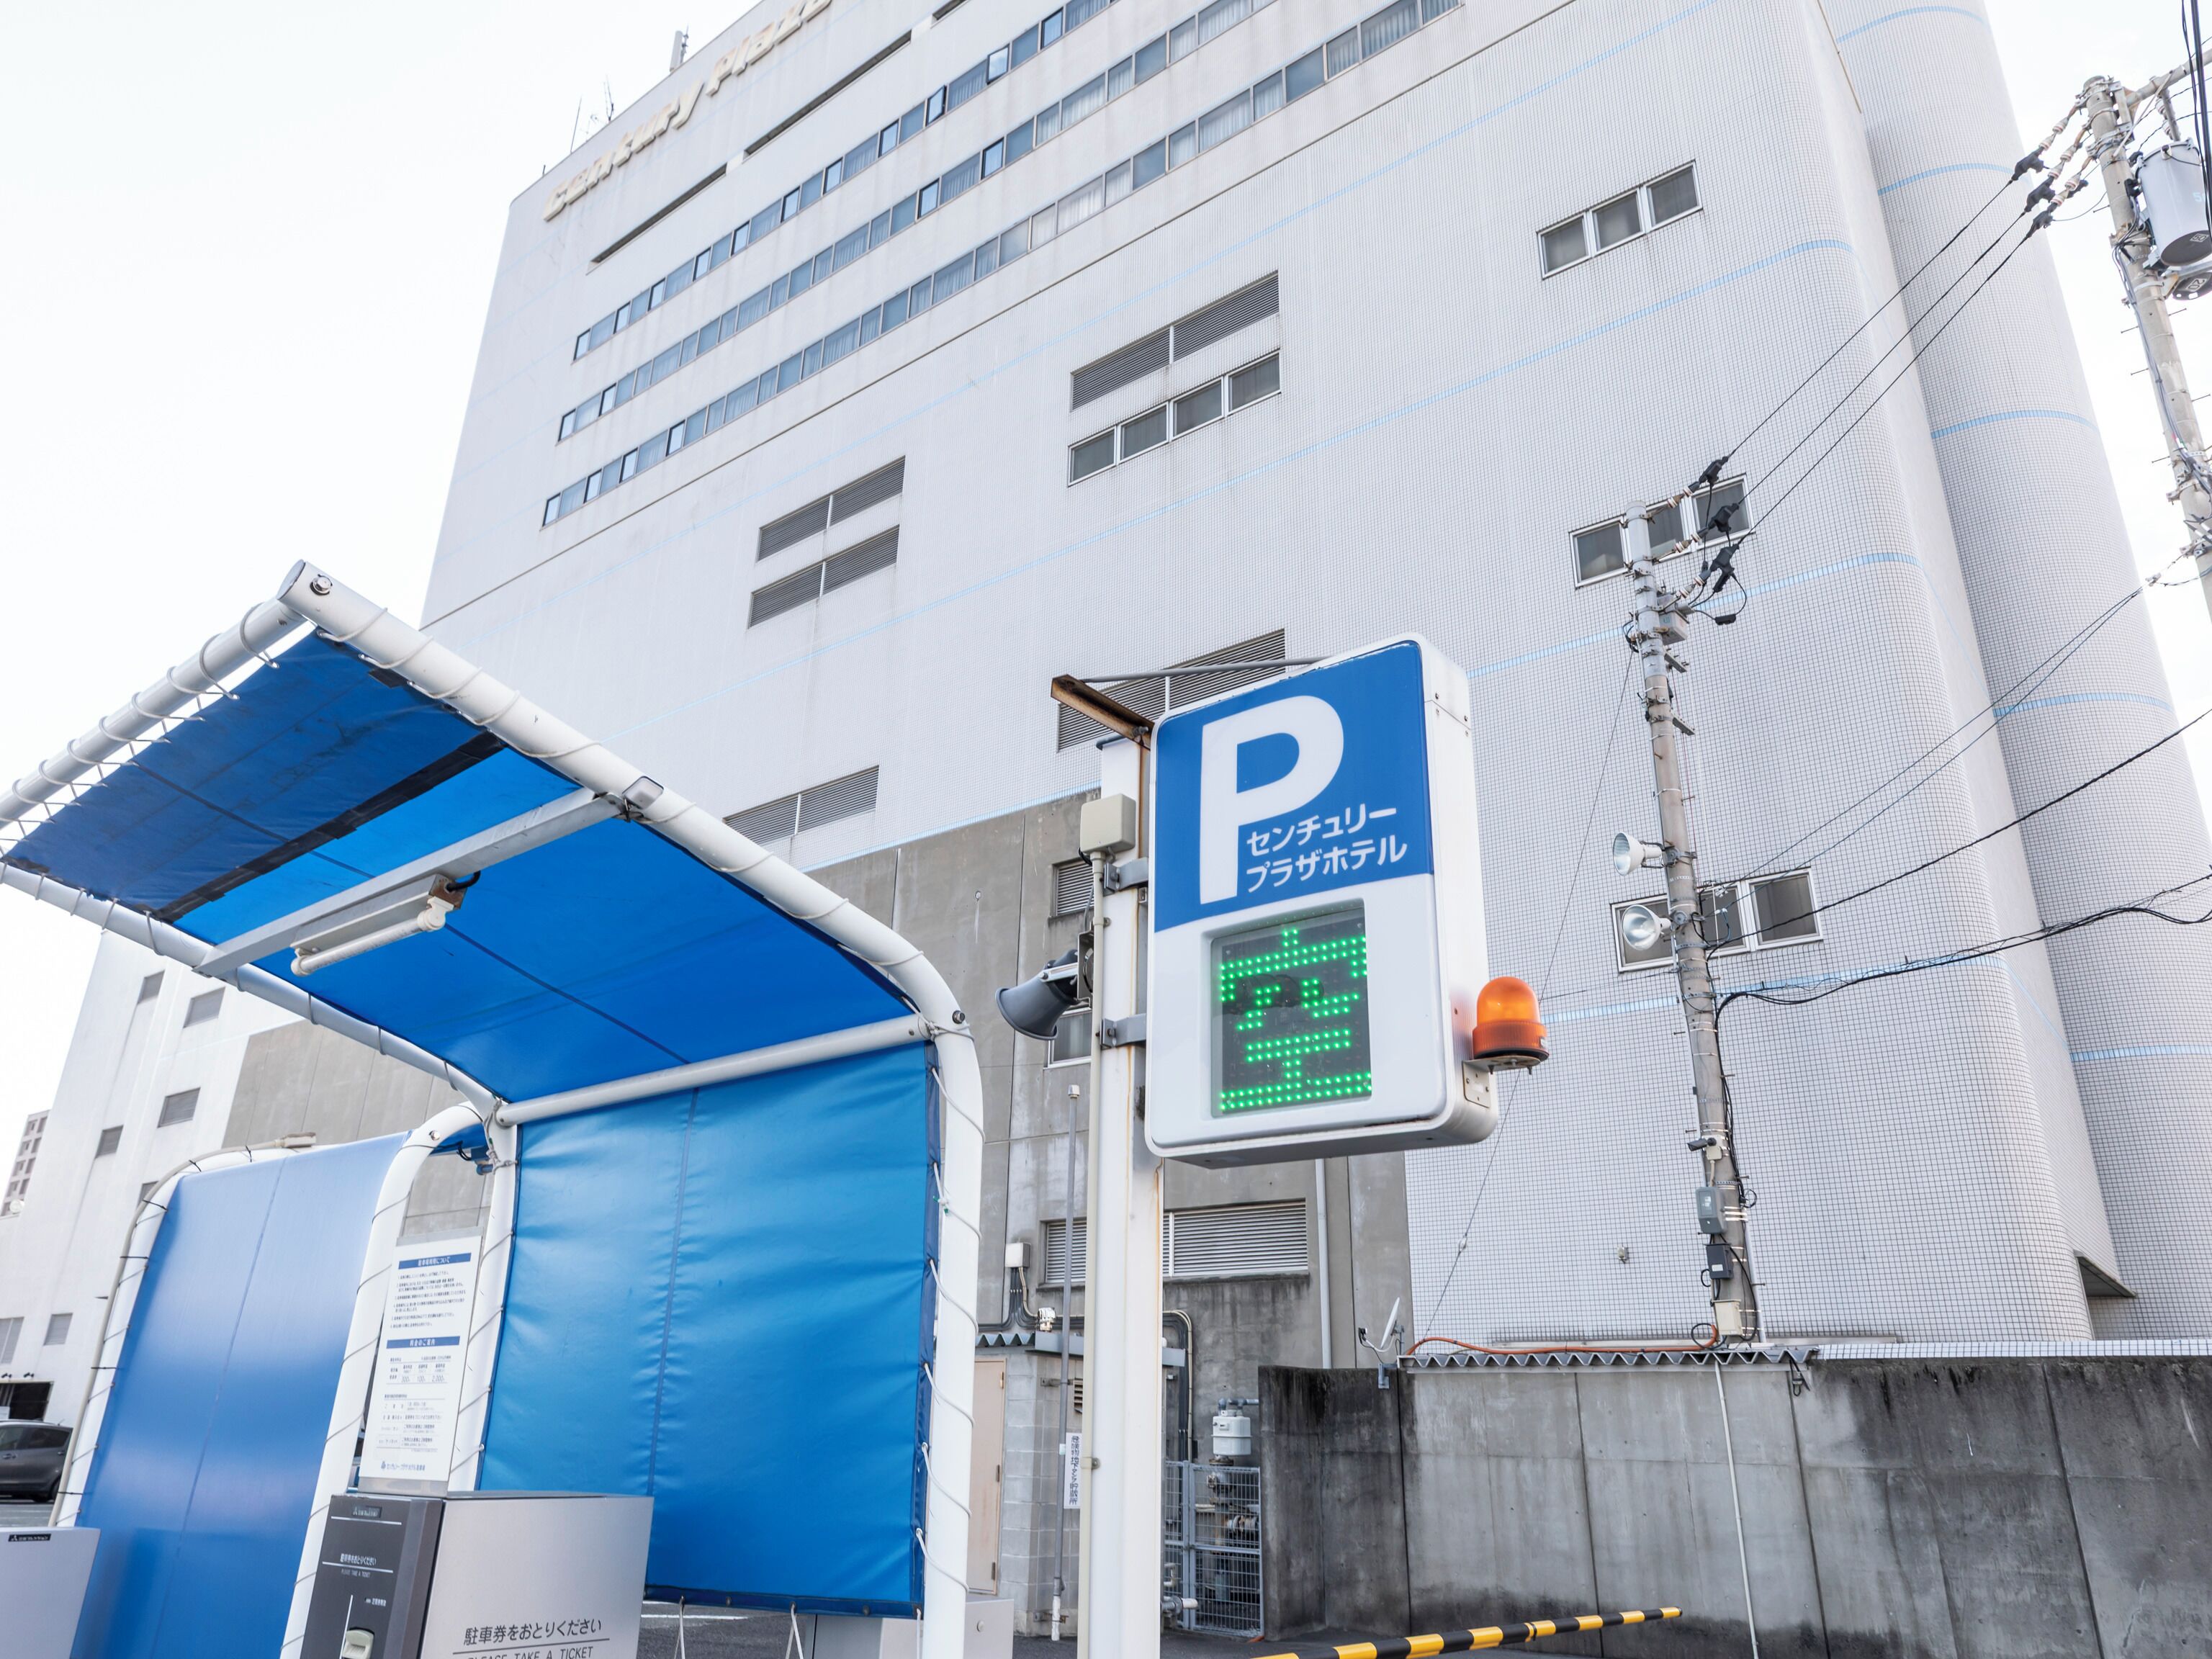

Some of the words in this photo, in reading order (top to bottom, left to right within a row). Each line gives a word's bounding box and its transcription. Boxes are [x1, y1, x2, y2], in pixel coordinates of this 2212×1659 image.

[1200, 696, 1344, 905] P
[1246, 804, 1397, 856] センチュリー
[1246, 835, 1408, 892] プラザホテル
[1220, 929, 1373, 1110] 空
[464, 1618, 601, 1646] 駐車券をおとりください
[559, 1646, 593, 1659] TICKET
